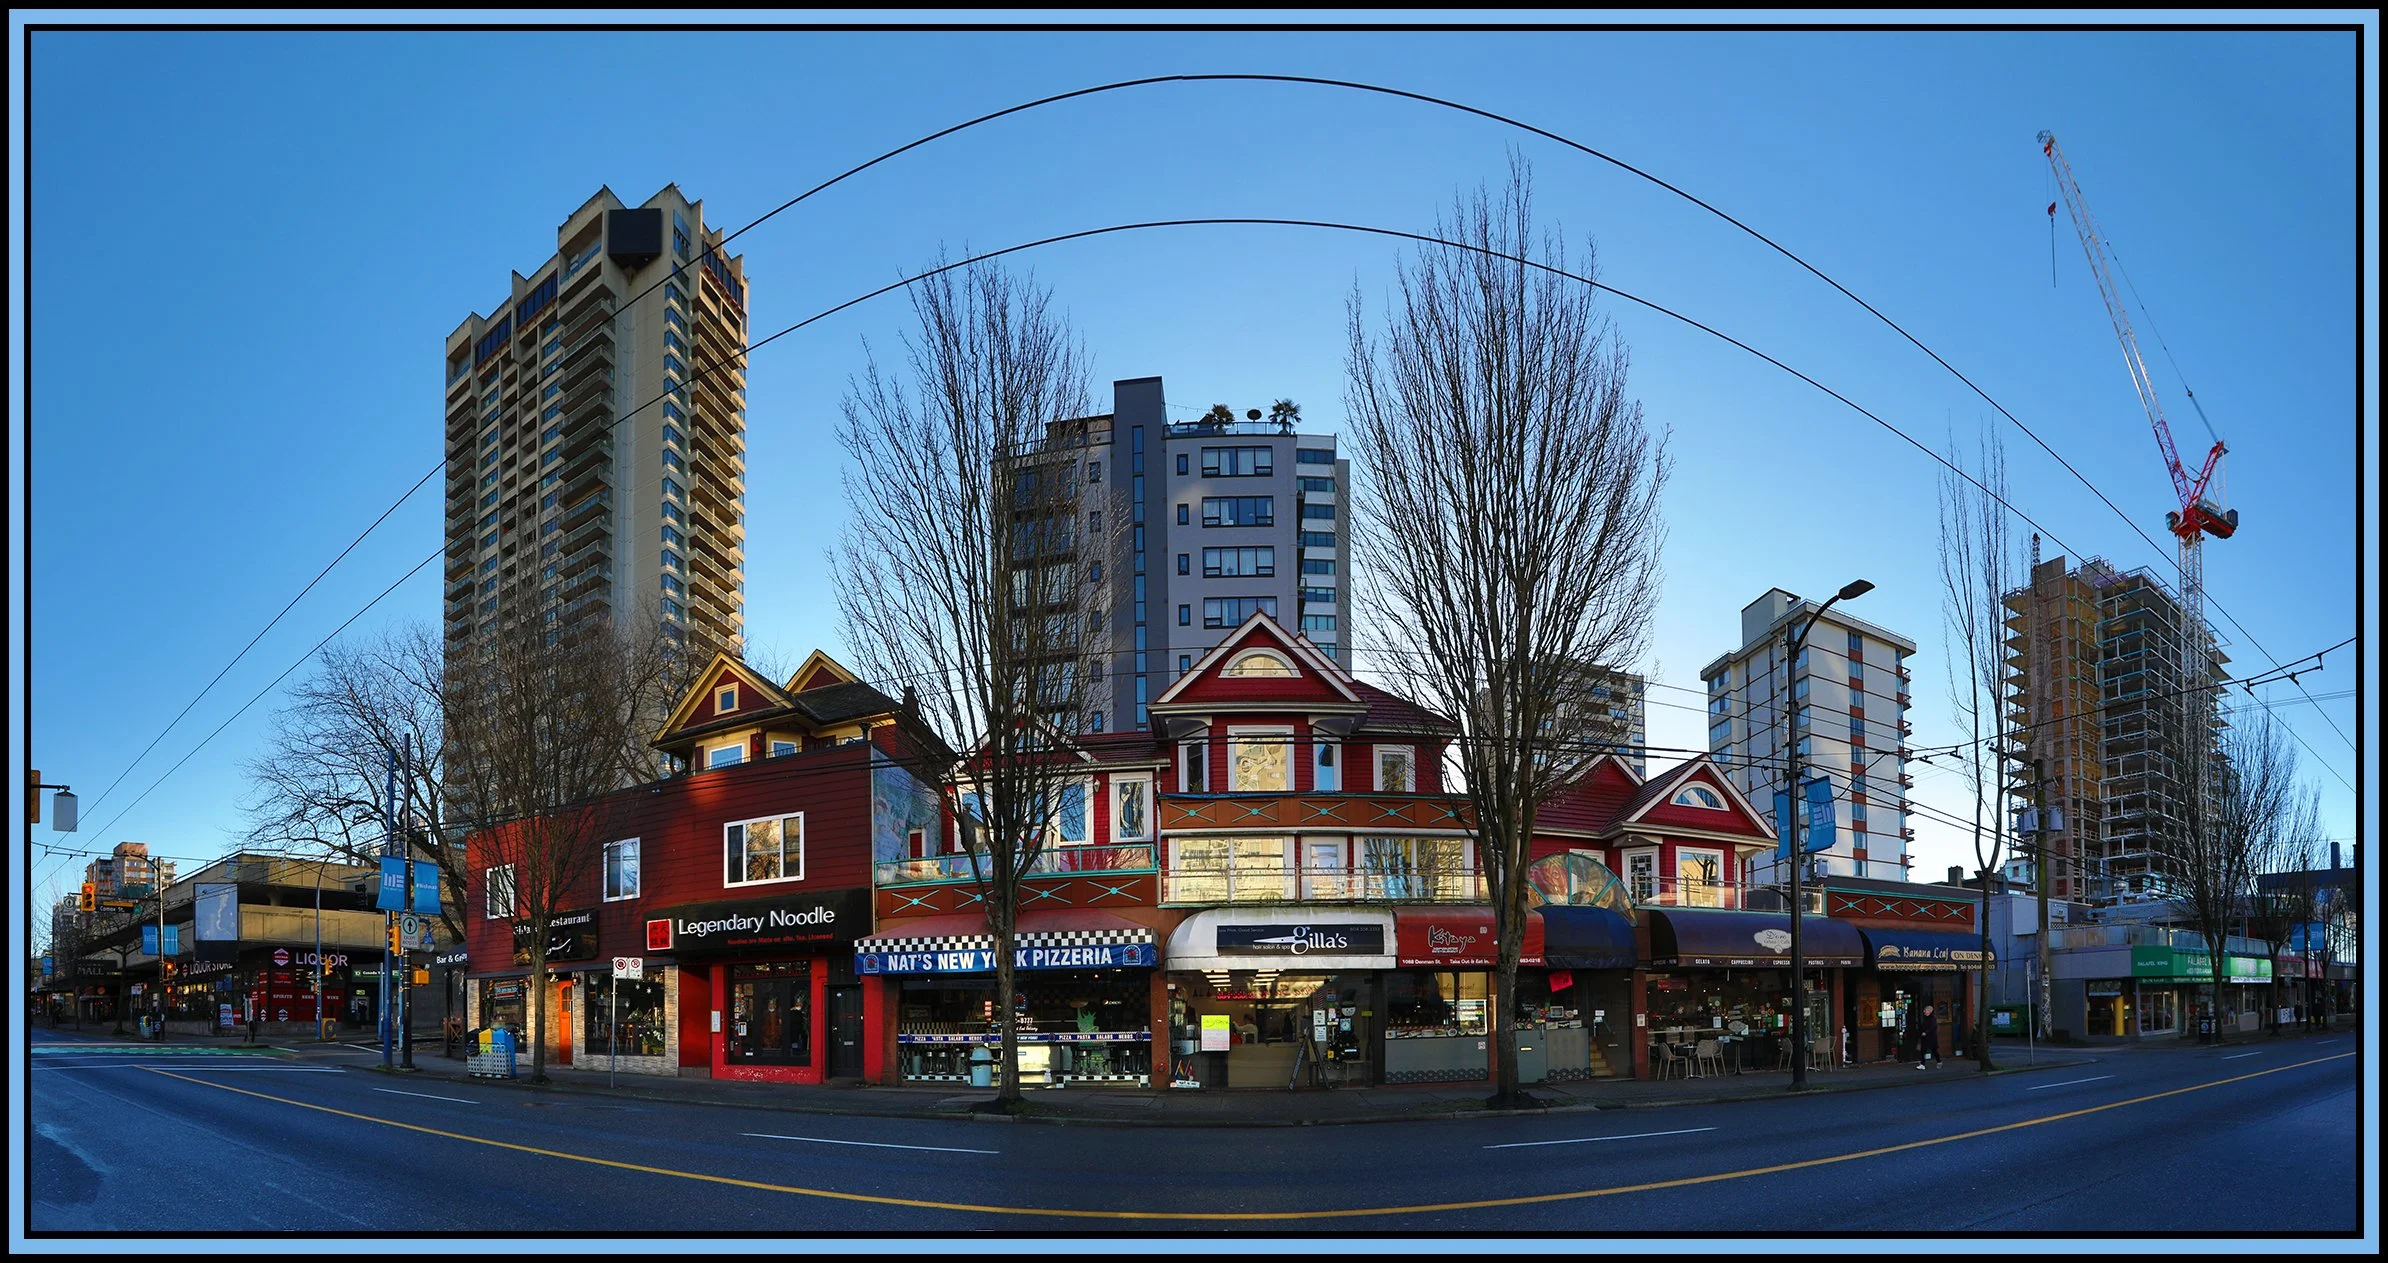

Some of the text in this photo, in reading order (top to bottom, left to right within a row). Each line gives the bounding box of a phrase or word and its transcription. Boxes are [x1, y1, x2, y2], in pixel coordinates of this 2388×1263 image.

[546, 913, 591, 927] estaurant
[679, 914, 764, 937] Legendary
[770, 906, 835, 927] Noodle
[437, 956, 447, 964] Bar
[448, 955, 453, 963] &
[888, 954, 933, 971] NAT'S
[938, 952, 975, 970] NEW
[1033, 947, 1113, 967] PIZZERIA
[1903, 946, 1949, 961] Banana Leaf
